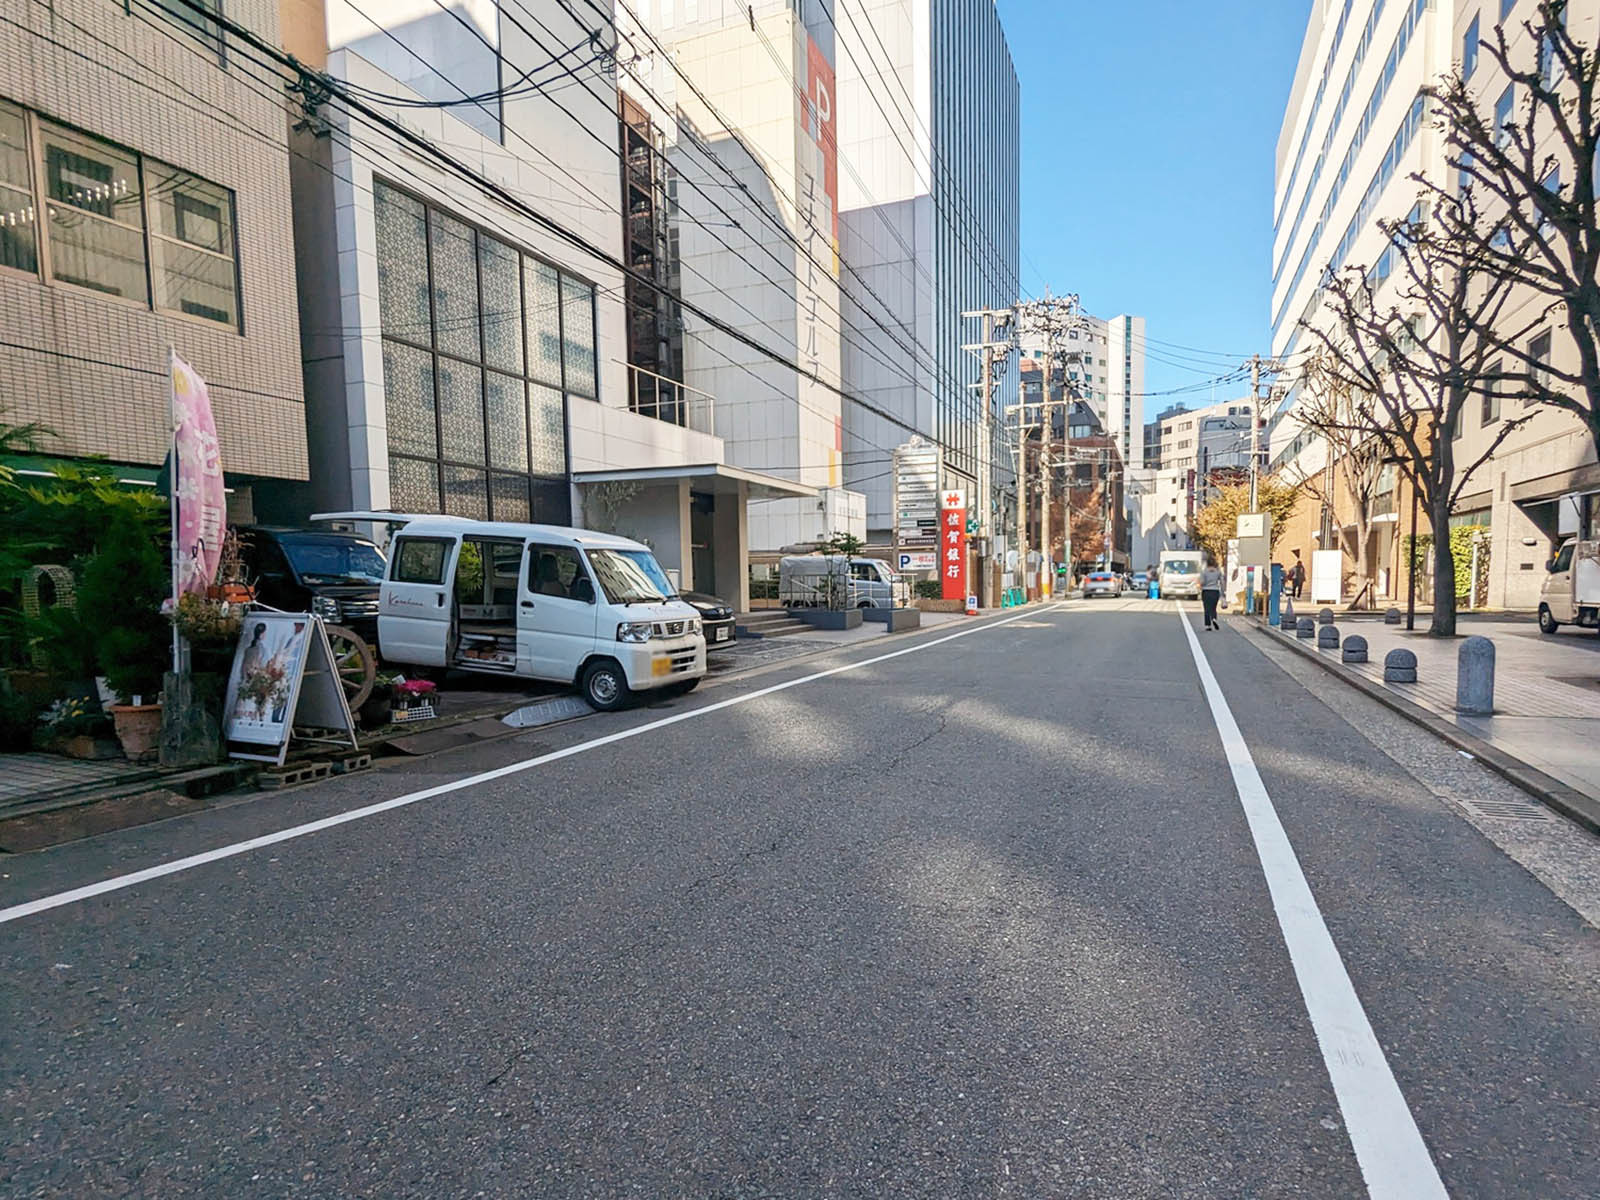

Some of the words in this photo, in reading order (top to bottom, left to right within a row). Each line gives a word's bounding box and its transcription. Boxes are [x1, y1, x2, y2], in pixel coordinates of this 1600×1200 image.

[900, 555, 911, 569] P
[946, 513, 960, 579] 佐賀銀行
